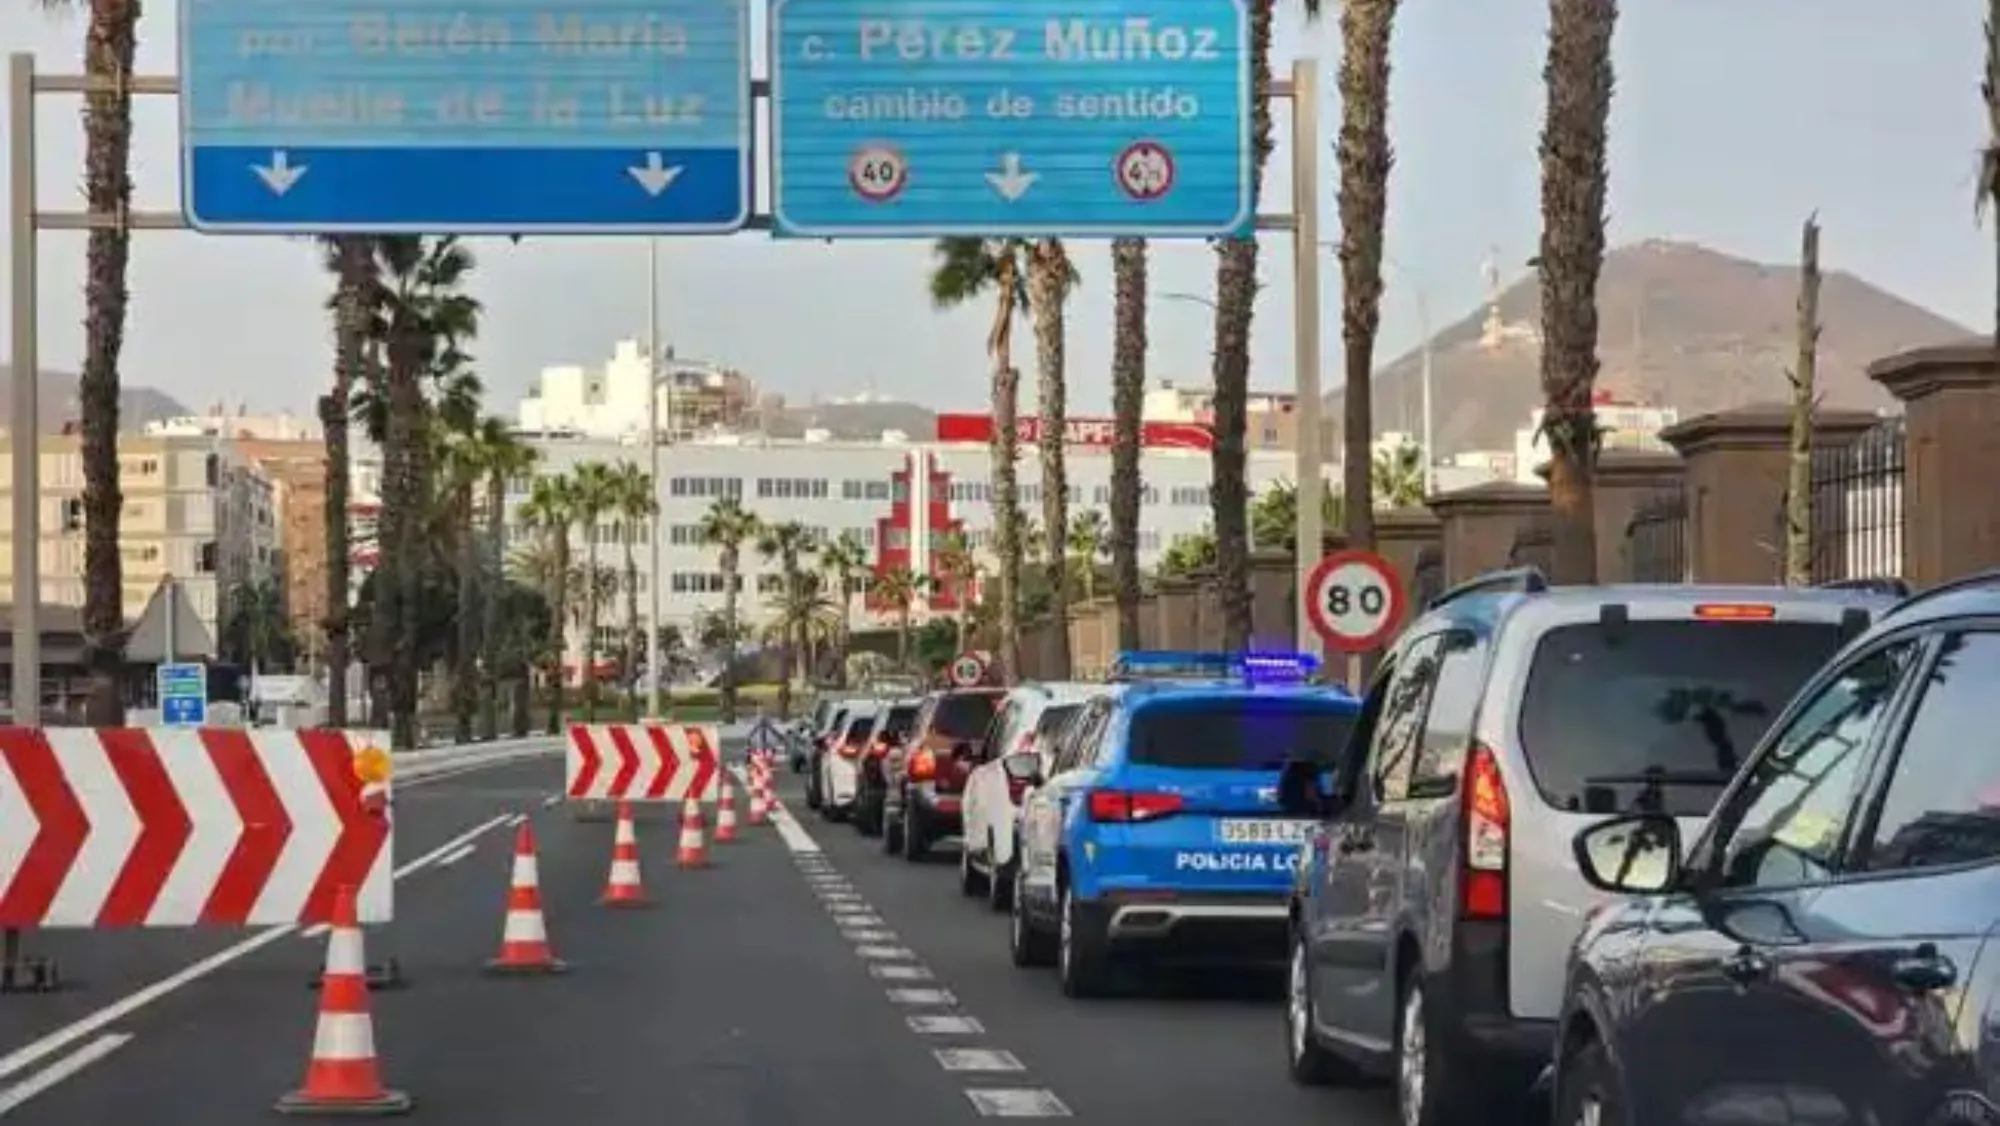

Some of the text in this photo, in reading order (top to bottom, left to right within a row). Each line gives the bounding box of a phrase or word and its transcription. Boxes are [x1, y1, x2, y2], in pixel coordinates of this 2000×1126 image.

[538, 12, 688, 54] María
[803, 17, 1221, 61] c. Pérez Muñoz
[227, 81, 706, 125] Muelle de la Luz
[825, 85, 1199, 119] cambio de sentido
[862, 160, 893, 181] 40
[1328, 585, 1383, 616] 80
[1176, 852, 1266, 870] POLICIA
